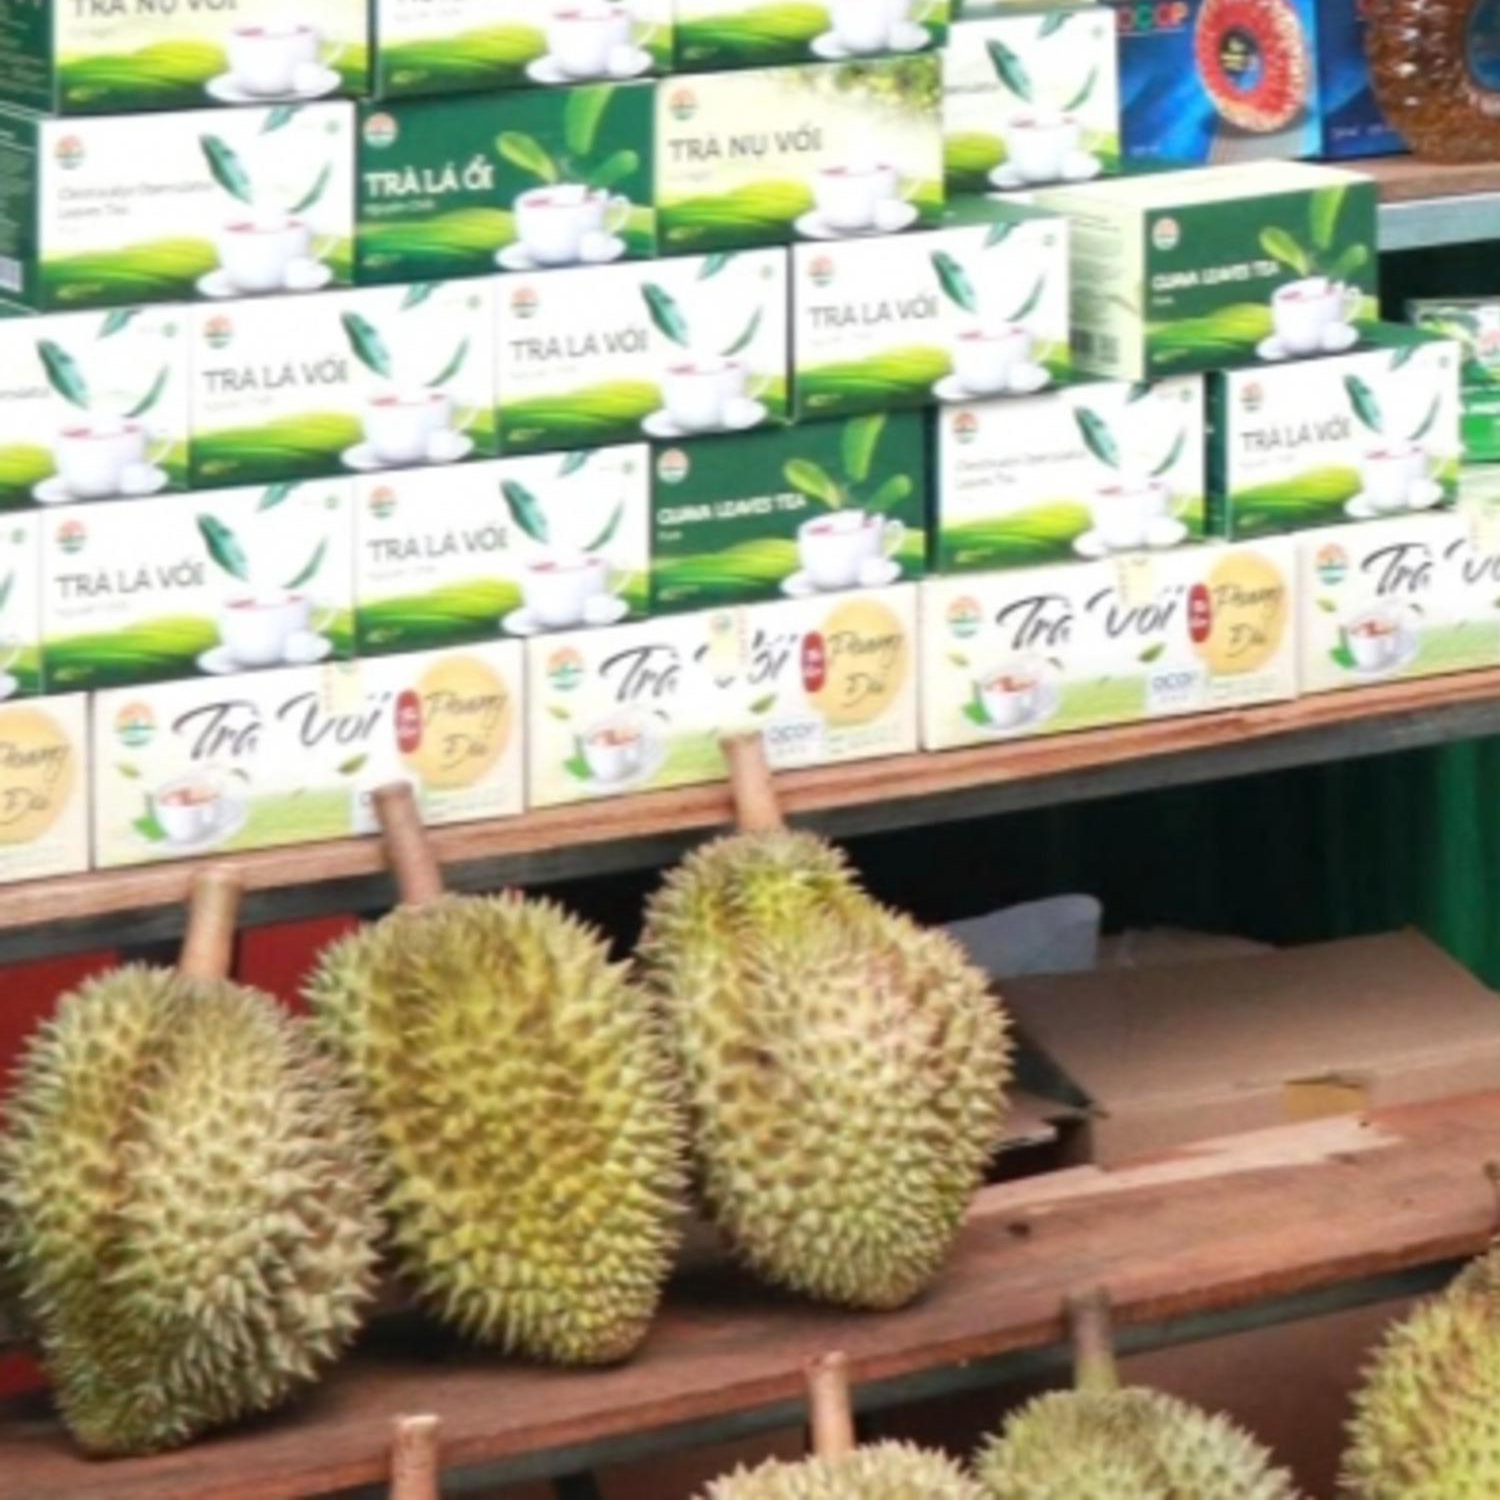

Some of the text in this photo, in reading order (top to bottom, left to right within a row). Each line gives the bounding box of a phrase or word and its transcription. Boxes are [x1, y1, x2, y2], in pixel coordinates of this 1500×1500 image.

[995, 594, 1075, 650] Trà
[599, 644, 681, 701] Trà
[171, 699, 262, 760] Trà
